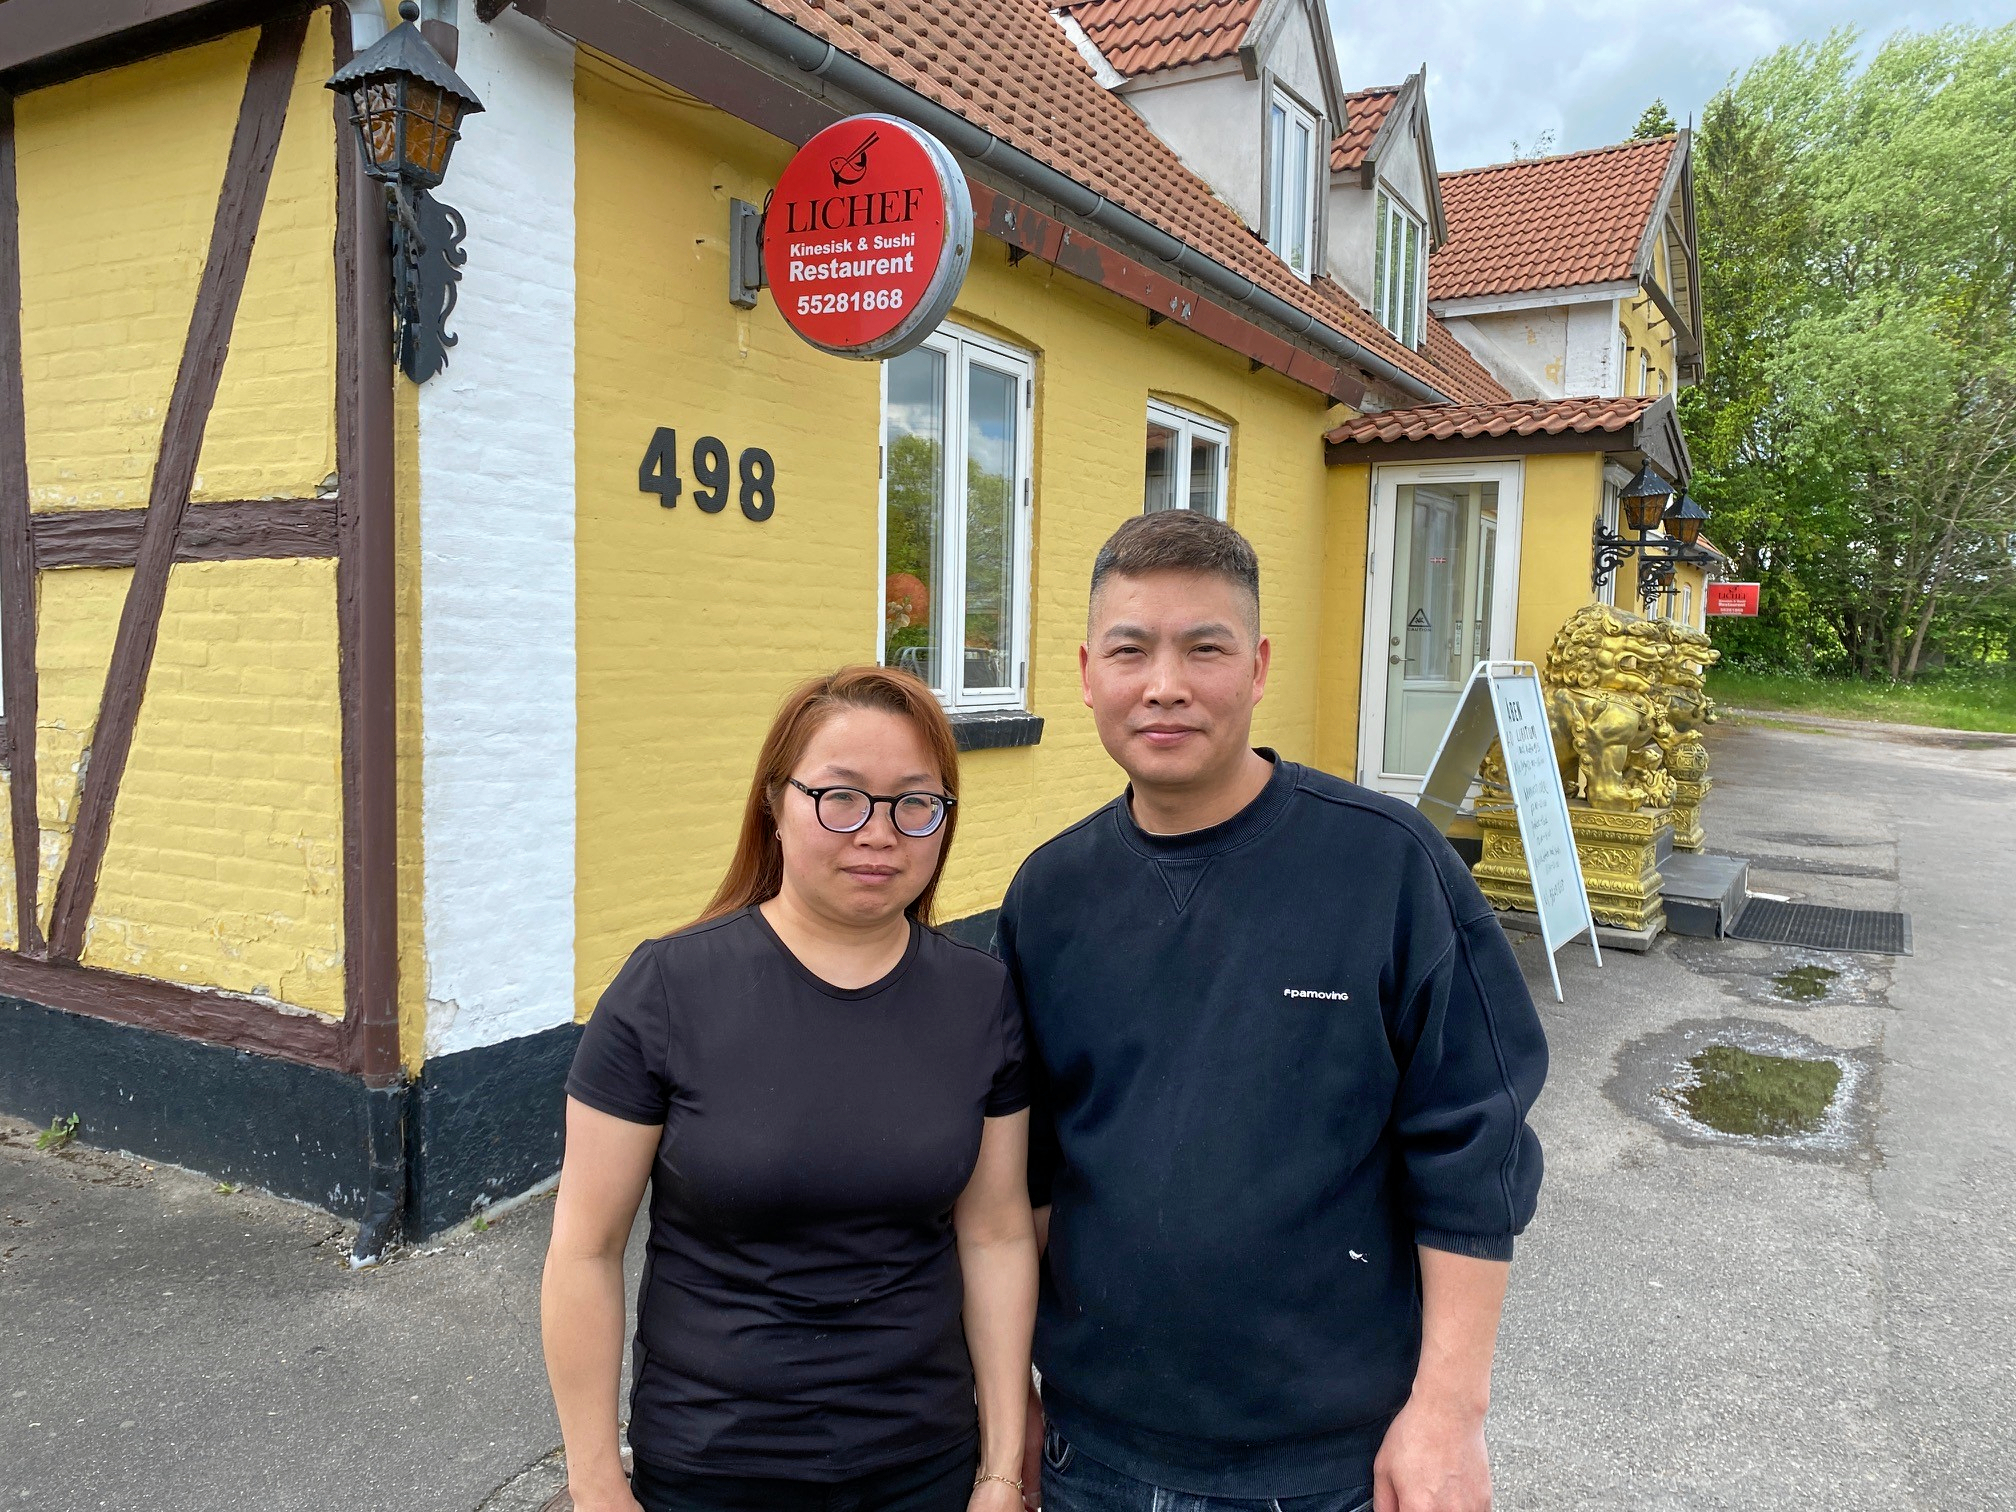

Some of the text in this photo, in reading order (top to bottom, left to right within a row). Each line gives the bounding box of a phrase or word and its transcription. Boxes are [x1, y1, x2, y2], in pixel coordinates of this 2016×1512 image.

[785, 187, 923, 234] LICHEF
[790, 233, 915, 258] Kinesisk & Sushi
[789, 251, 914, 282] Restaurent
[797, 289, 903, 316] 55281868
[639, 426, 775, 522] 498
